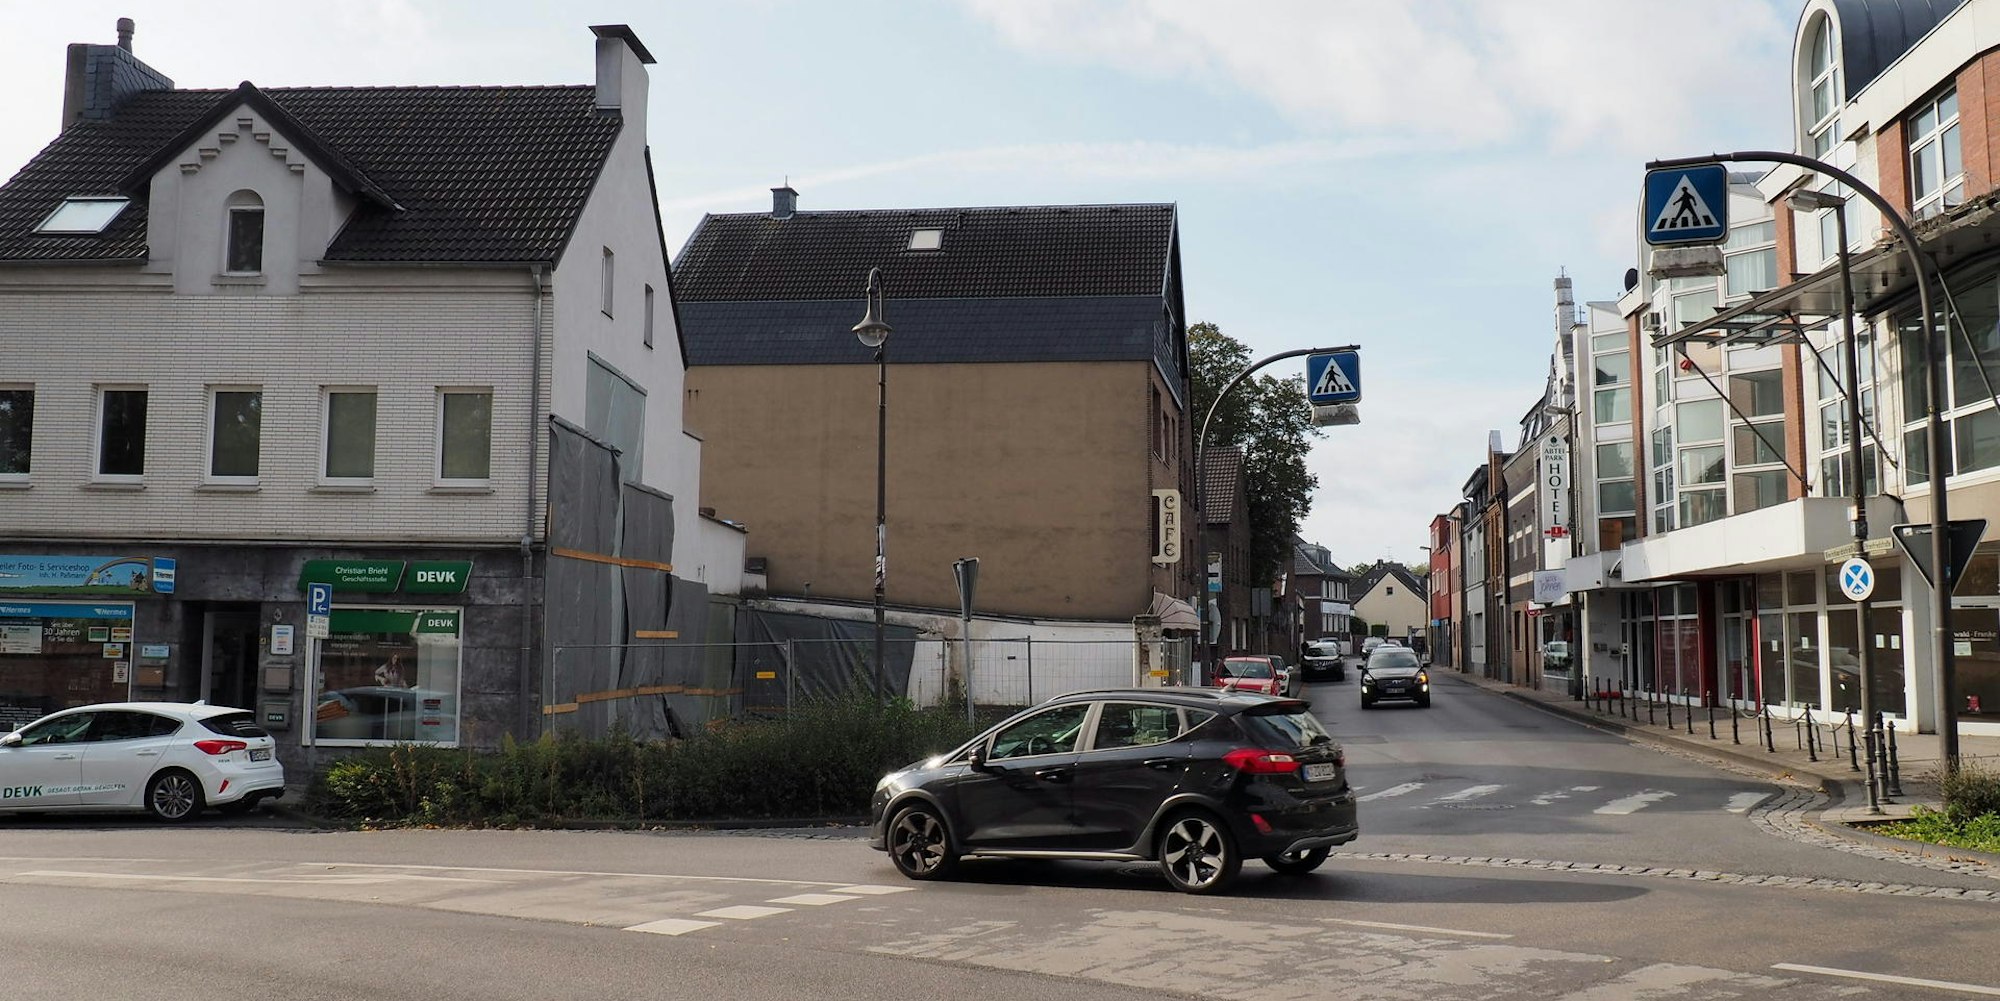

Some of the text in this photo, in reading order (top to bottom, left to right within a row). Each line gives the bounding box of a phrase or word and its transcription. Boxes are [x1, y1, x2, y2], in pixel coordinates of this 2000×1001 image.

[1549, 463, 1562, 526] HOTEL
[47, 562, 90, 573] Serviceshop
[335, 566, 388, 575] Christian Briehl
[416, 571, 456, 583] DEVK
[312, 587, 326, 611] P
[5, 606, 31, 614] Hermes
[102, 608, 127, 616] Hermes
[427, 619, 453, 627] DEVK
[44, 628, 53, 636] 30
[54, 627, 80, 637] Jahren
[3, 785, 42, 799] DEVK
